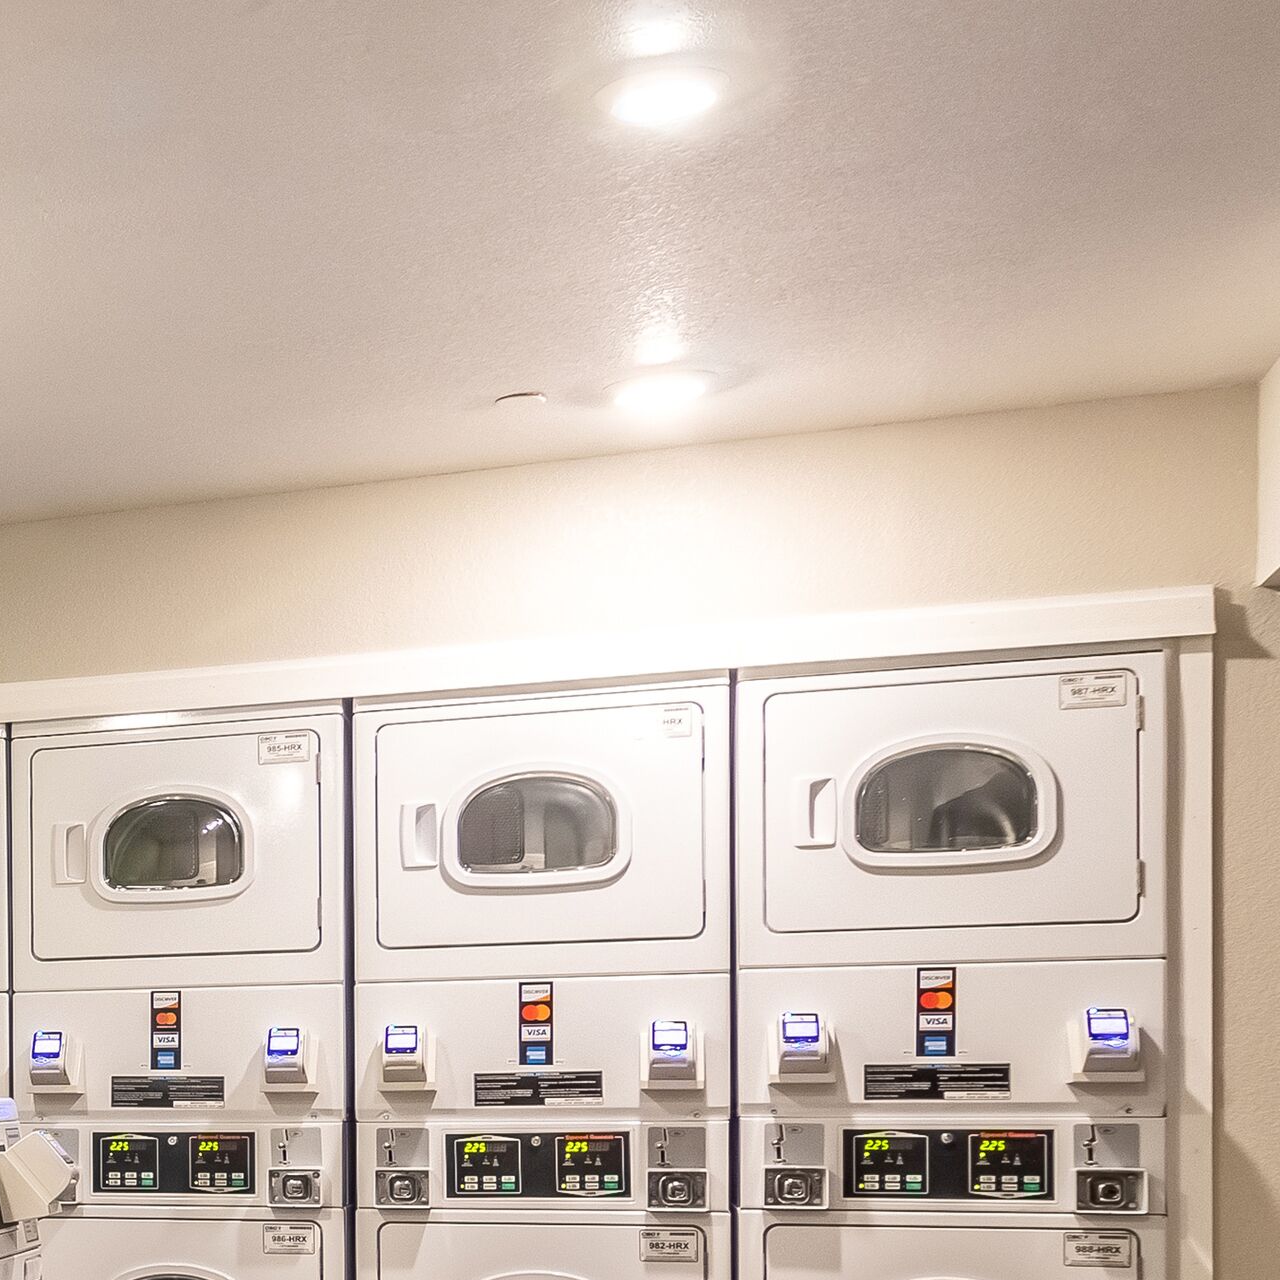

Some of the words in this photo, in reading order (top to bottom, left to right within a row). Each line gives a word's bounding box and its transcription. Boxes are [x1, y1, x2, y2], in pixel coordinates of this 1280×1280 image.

[267, 743, 302, 753] 985-HRX
[924, 1017, 949, 1025] VISA
[271, 1235, 307, 1243] 986-HRX
[649, 1242, 689, 1250] 982-HRX
